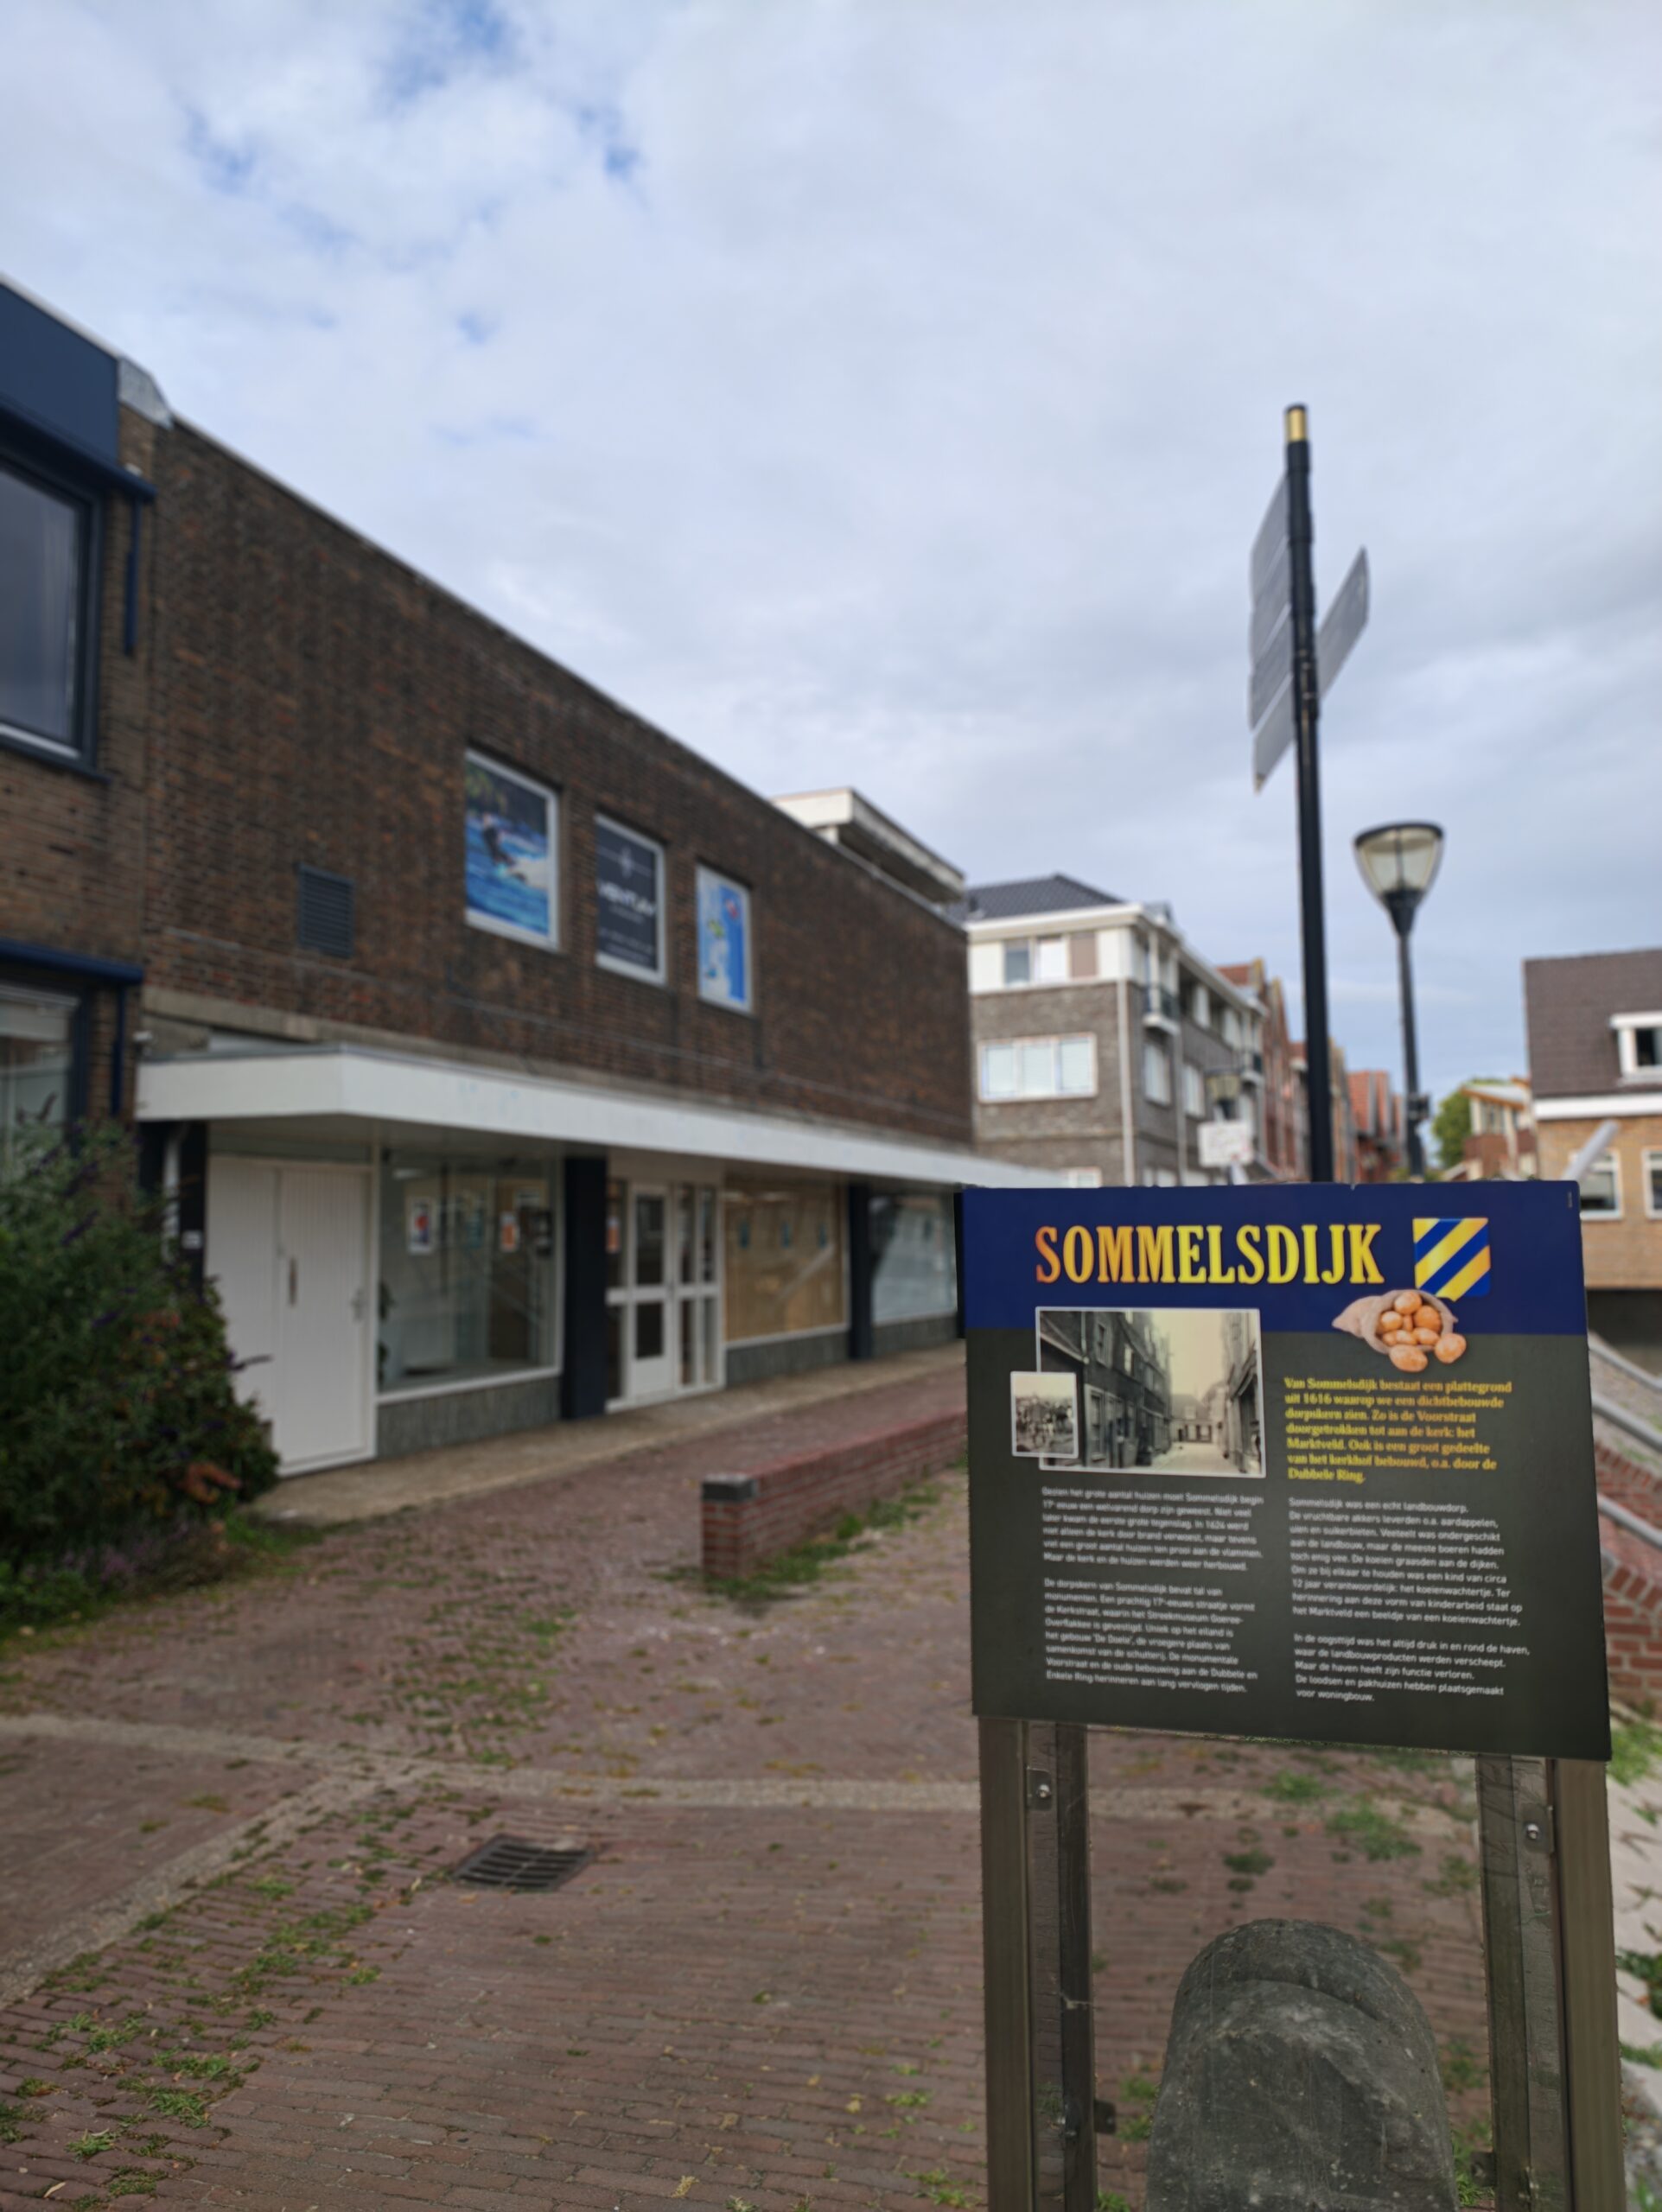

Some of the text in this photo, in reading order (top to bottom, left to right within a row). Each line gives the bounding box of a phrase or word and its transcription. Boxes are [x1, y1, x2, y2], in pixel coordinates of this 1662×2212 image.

[1035, 1224, 1385, 1284] SOMMELSDIJK
[1289, 1497, 1343, 1510] Sommelsdijk
[1382, 1501, 1401, 1510] echt
[1289, 1510, 1301, 1521] De
[1302, 1511, 1349, 1522] vruchtbare
[1351, 1513, 1380, 1523] akkers
[1382, 1514, 1420, 1524] leverden
[1289, 1525, 1309, 1535] uien
[1380, 1528, 1416, 1538] Veeteelt
[1417, 1530, 1435, 1539] was
[1437, 1529, 1500, 1541] ondergeschikt
[1308, 1539, 1318, 1548] de
[1366, 1542, 1388, 1551] maar
[1391, 1541, 1402, 1551] de
[1404, 1543, 1436, 1553] meeste
[1437, 1543, 1468, 1554] boeren
[1471, 1544, 1504, 1554] hadden
[1290, 1552, 1310, 1561] toch
[1309, 1554, 1330, 1565] enig
[1351, 1554, 1363, 1564] De
[1365, 1554, 1393, 1565] koeien
[1395, 1556, 1436, 1567] graasden
[1438, 1559, 1454, 1567] aan
[1456, 1558, 1467, 1567] de
[1291, 1565, 1306, 1574] Om
[1319, 1566, 1331, 1578] bij
[1332, 1567, 1359, 1577] elkaar
[1361, 1568, 1370, 1577] te
[1372, 1568, 1404, 1579] houden
[1444, 1571, 1464, 1581] kind
[1485, 1573, 1506, 1583] circa
[1292, 1579, 1302, 1588] 12
[1303, 1580, 1321, 1591] jaar
[1399, 1583, 1414, 1593] het
[1497, 1589, 1511, 1598] Ter
[1292, 1592, 1342, 1606] herinnering
[1361, 1595, 1382, 1605] deze
[1385, 1599, 1407, 1607] vorm
[1427, 1599, 1484, 1610] kinderarbeid
[1487, 1602, 1508, 1611] staat
[1511, 1604, 1522, 1614] op
[1293, 1606, 1307, 1616] het
[1308, 1606, 1353, 1618] Marktveld
[1372, 1610, 1403, 1622] beeldje
[1294, 1633, 1302, 1643] In
[1304, 1634, 1315, 1643] de
[1317, 1636, 1355, 1648] oogsttijd
[1357, 1638, 1374, 1647] was
[1376, 1637, 1390, 1648] het
[1392, 1638, 1415, 1650] altijd
[1417, 1639, 1436, 1649] druk
[1439, 1641, 1448, 1650] in
[1463, 1643, 1484, 1652] rond
[1487, 1643, 1497, 1653] de
[1295, 1649, 1315, 1657] waar
[1317, 1648, 1328, 1658] de
[1330, 1649, 1416, 1663] landbouwproducten
[1418, 1655, 1451, 1665] werden
[1295, 1661, 1315, 1671] Maar
[1319, 1662, 1329, 1672] de
[1331, 1662, 1358, 1674] haven
[1360, 1664, 1382, 1675] heeft
[1385, 1667, 1399, 1678] zijn
[1401, 1667, 1431, 1678] functie
[1296, 1675, 1503, 1695] De loodsen en pakhuizen hebben plaatsgemaakt
[1296, 1690, 1315, 1699] voor
